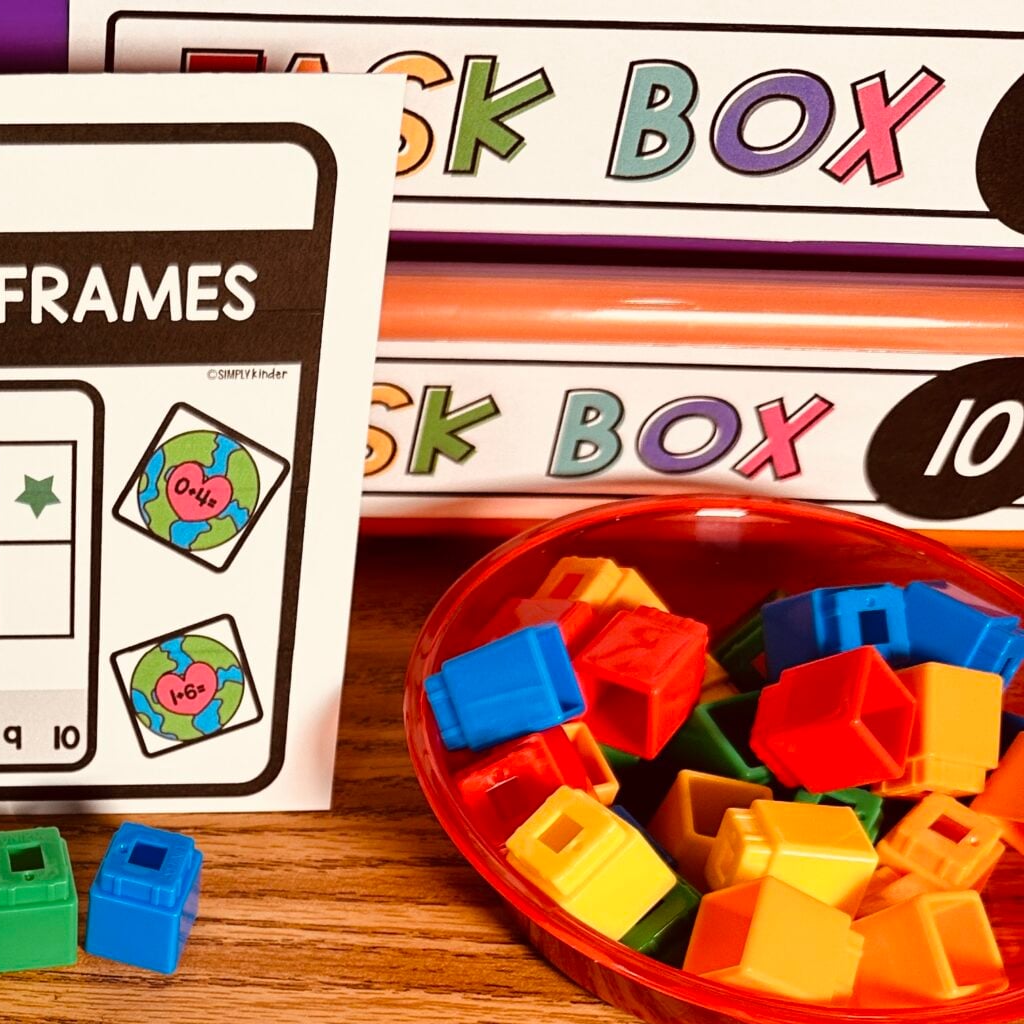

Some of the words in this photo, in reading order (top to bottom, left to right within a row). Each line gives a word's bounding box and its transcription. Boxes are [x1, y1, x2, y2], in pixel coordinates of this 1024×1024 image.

[606, 60, 946, 187] BOX
[546, 388, 834, 482] BOX
[923, 398, 1024, 478] 10
[174, 477, 217, 508] 0+4=
[3, 725, 23, 750] 9
[53, 725, 80, 750] 10
